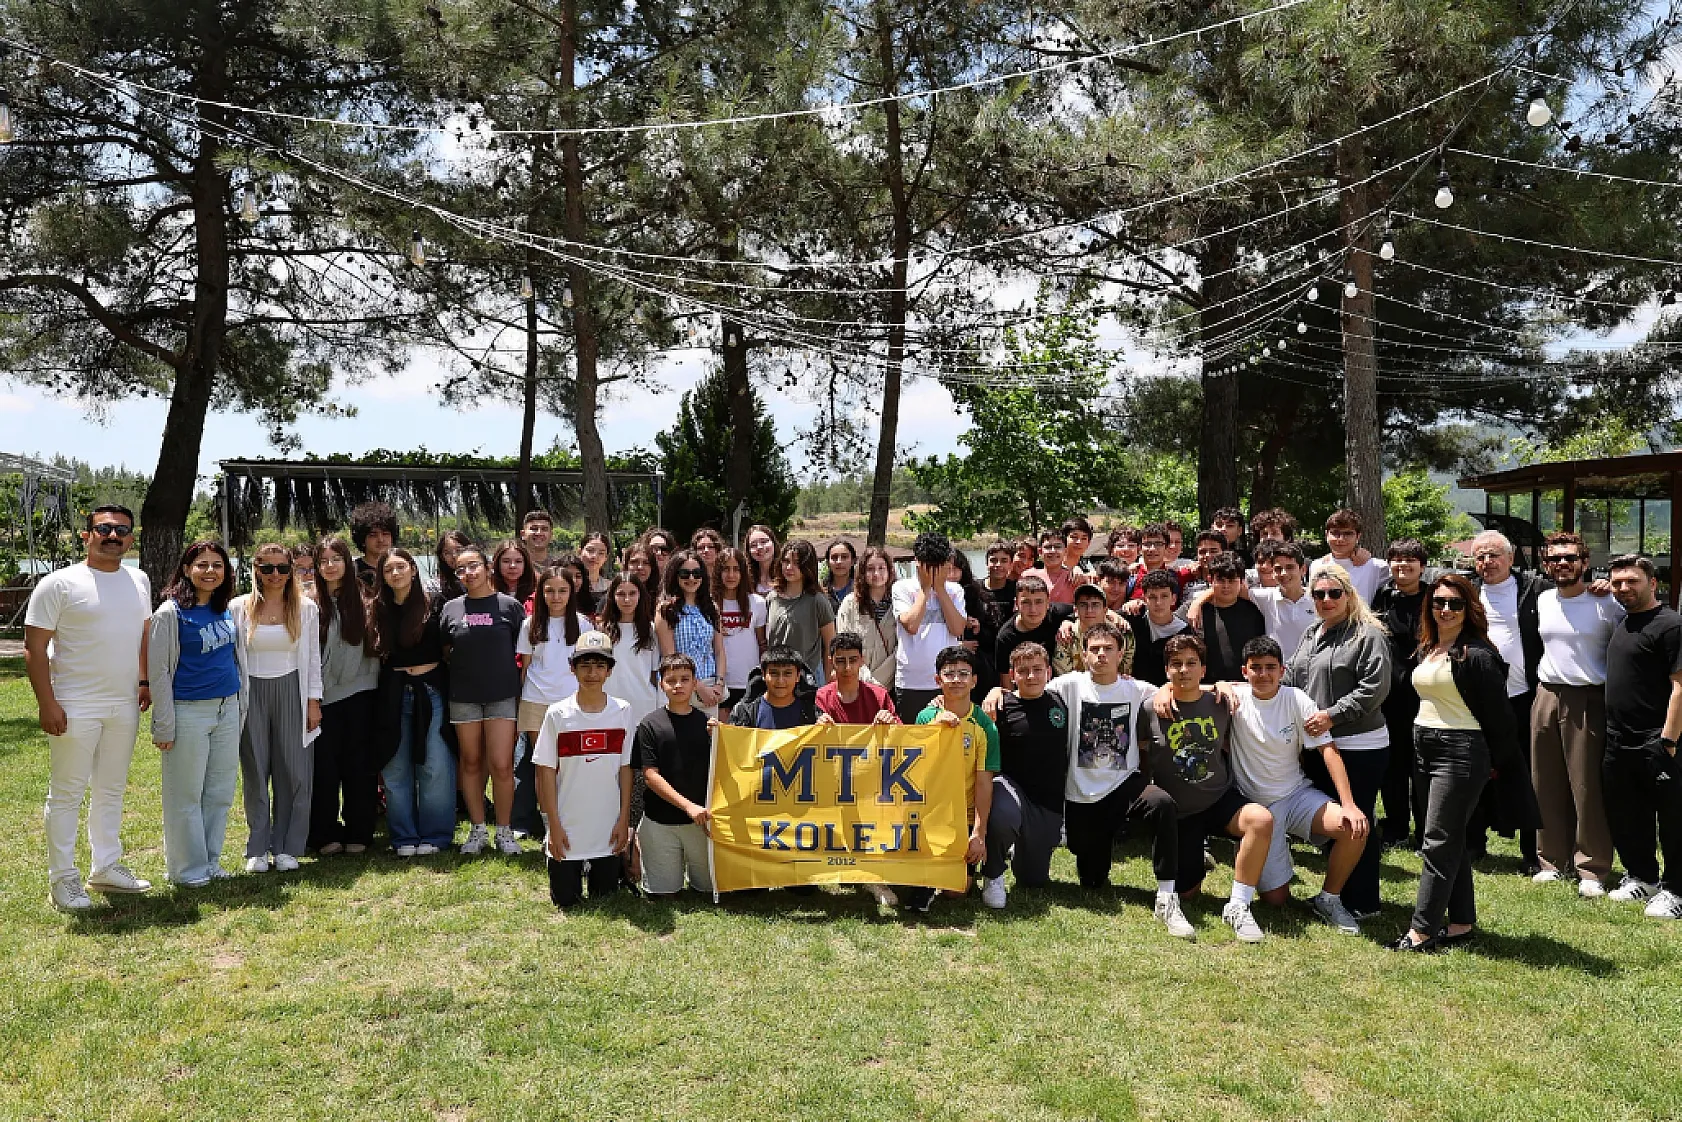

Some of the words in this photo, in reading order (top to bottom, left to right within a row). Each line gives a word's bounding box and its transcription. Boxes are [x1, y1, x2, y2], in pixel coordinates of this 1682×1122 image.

[755, 745, 926, 805] MTK
[760, 812, 920, 851] KOLEJİ
[827, 856, 857, 866] 2012
